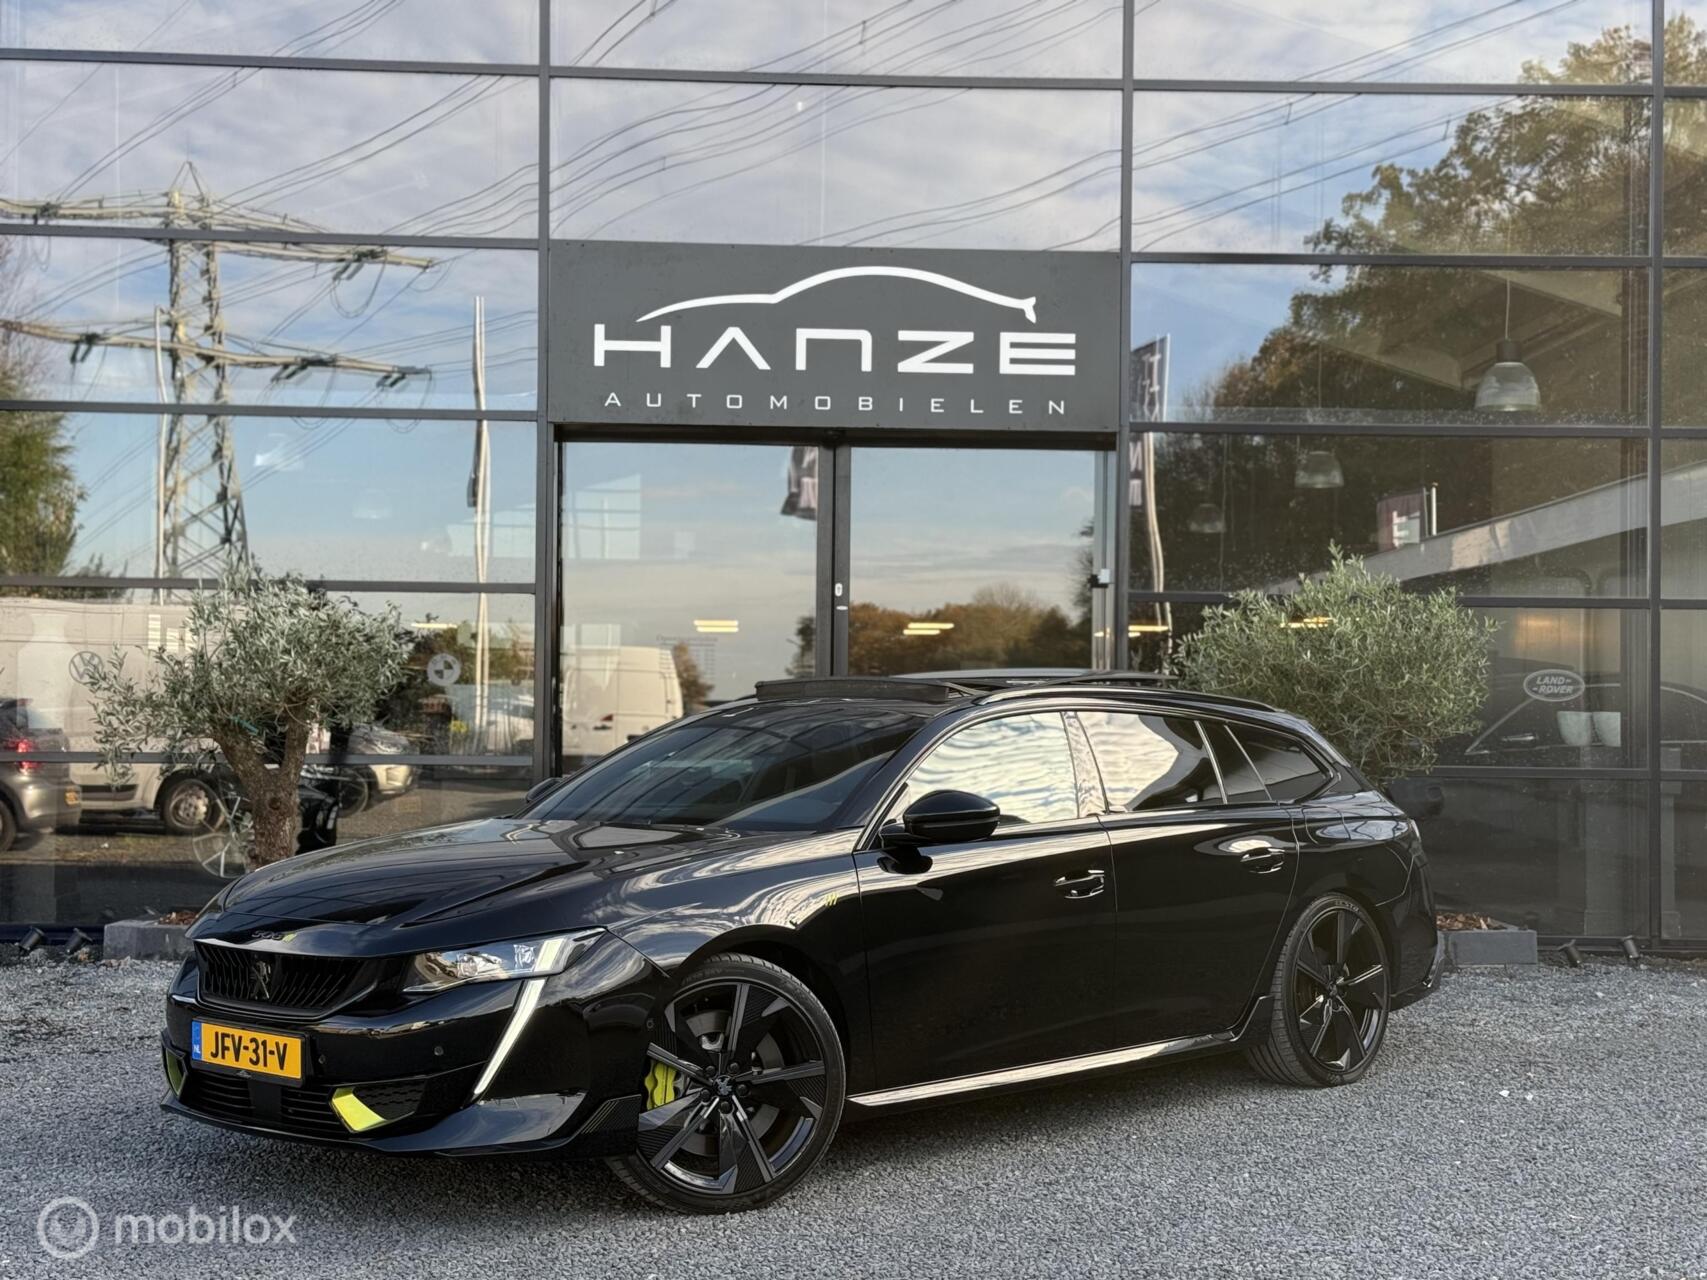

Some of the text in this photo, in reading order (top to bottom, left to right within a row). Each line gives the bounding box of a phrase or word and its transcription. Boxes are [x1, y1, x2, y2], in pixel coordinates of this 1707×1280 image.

[593, 323, 1077, 376] HANZE
[604, 391, 1066, 416] AUTOMOBIELEN
[210, 1031, 288, 1071] JFV-31-V
